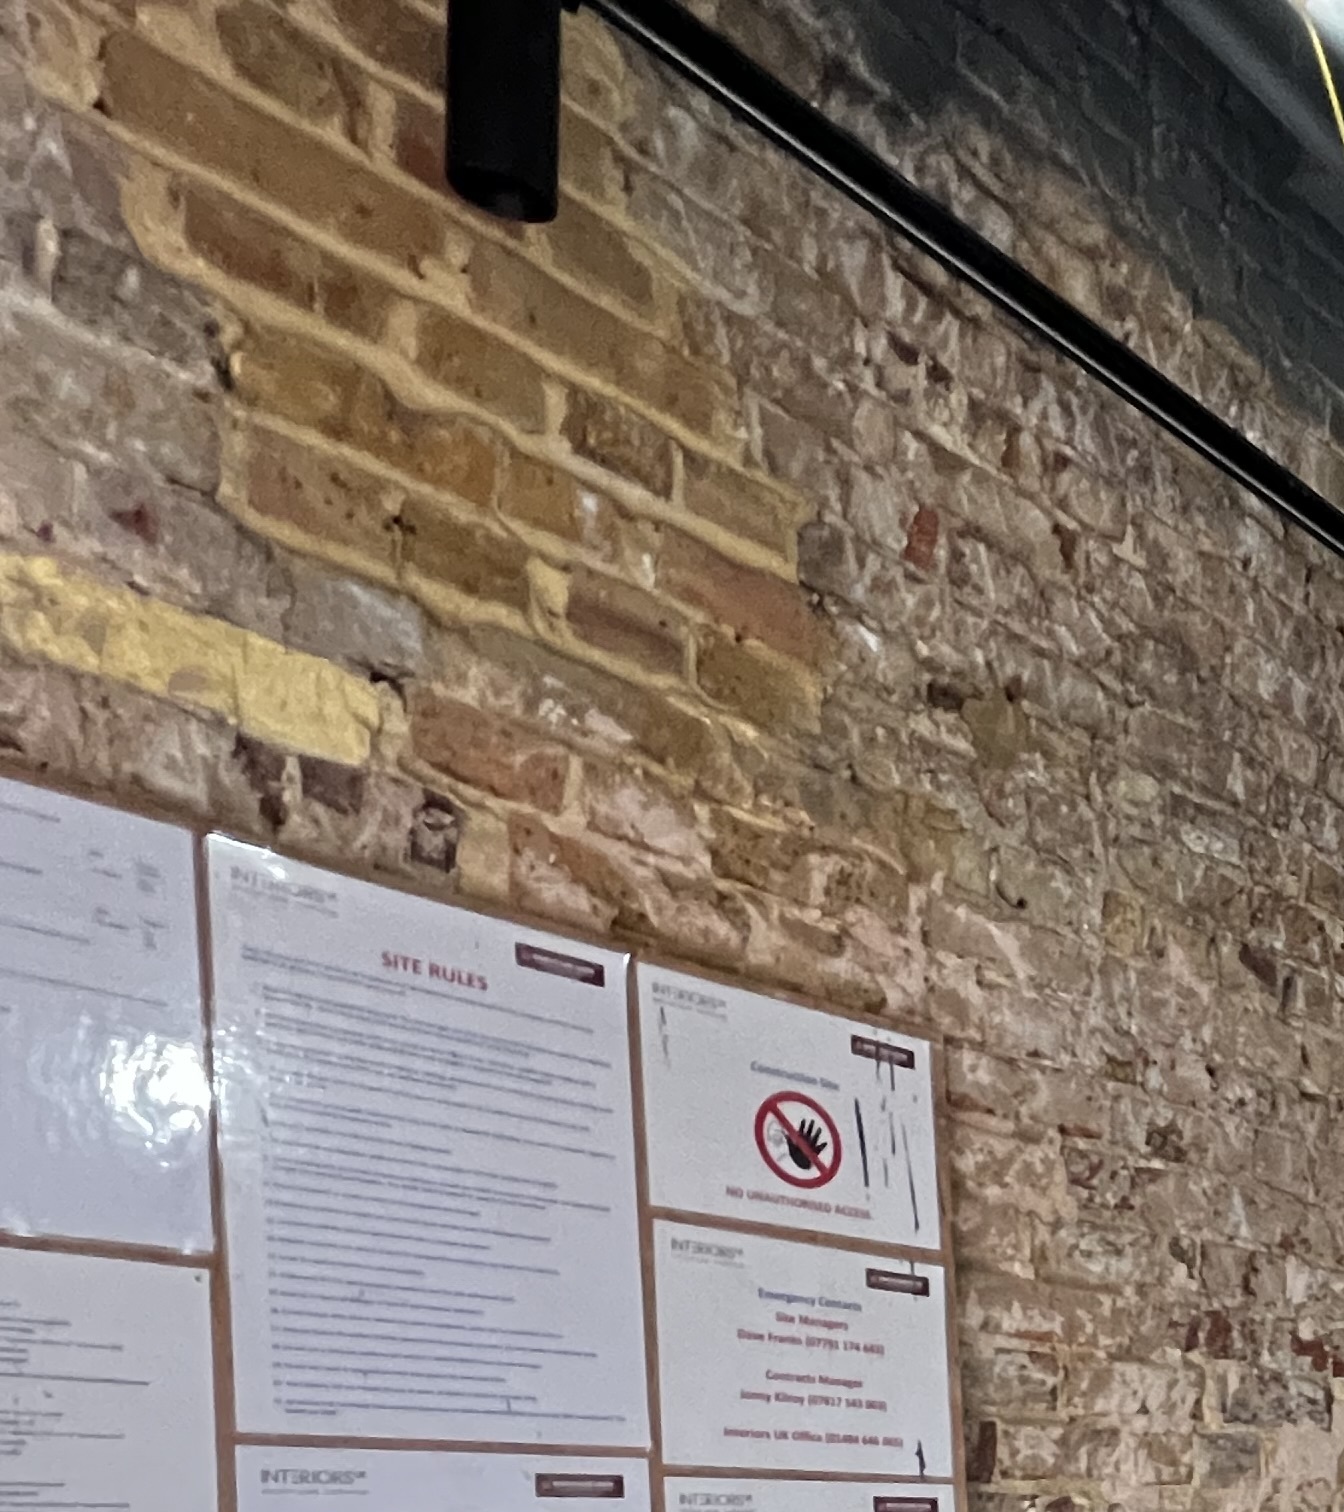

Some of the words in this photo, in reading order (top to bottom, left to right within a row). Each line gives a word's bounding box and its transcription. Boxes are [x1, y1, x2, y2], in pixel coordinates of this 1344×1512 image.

[381, 951, 422, 976] SITE
[428, 961, 489, 991] RULES
[726, 1186, 744, 1198] NO
